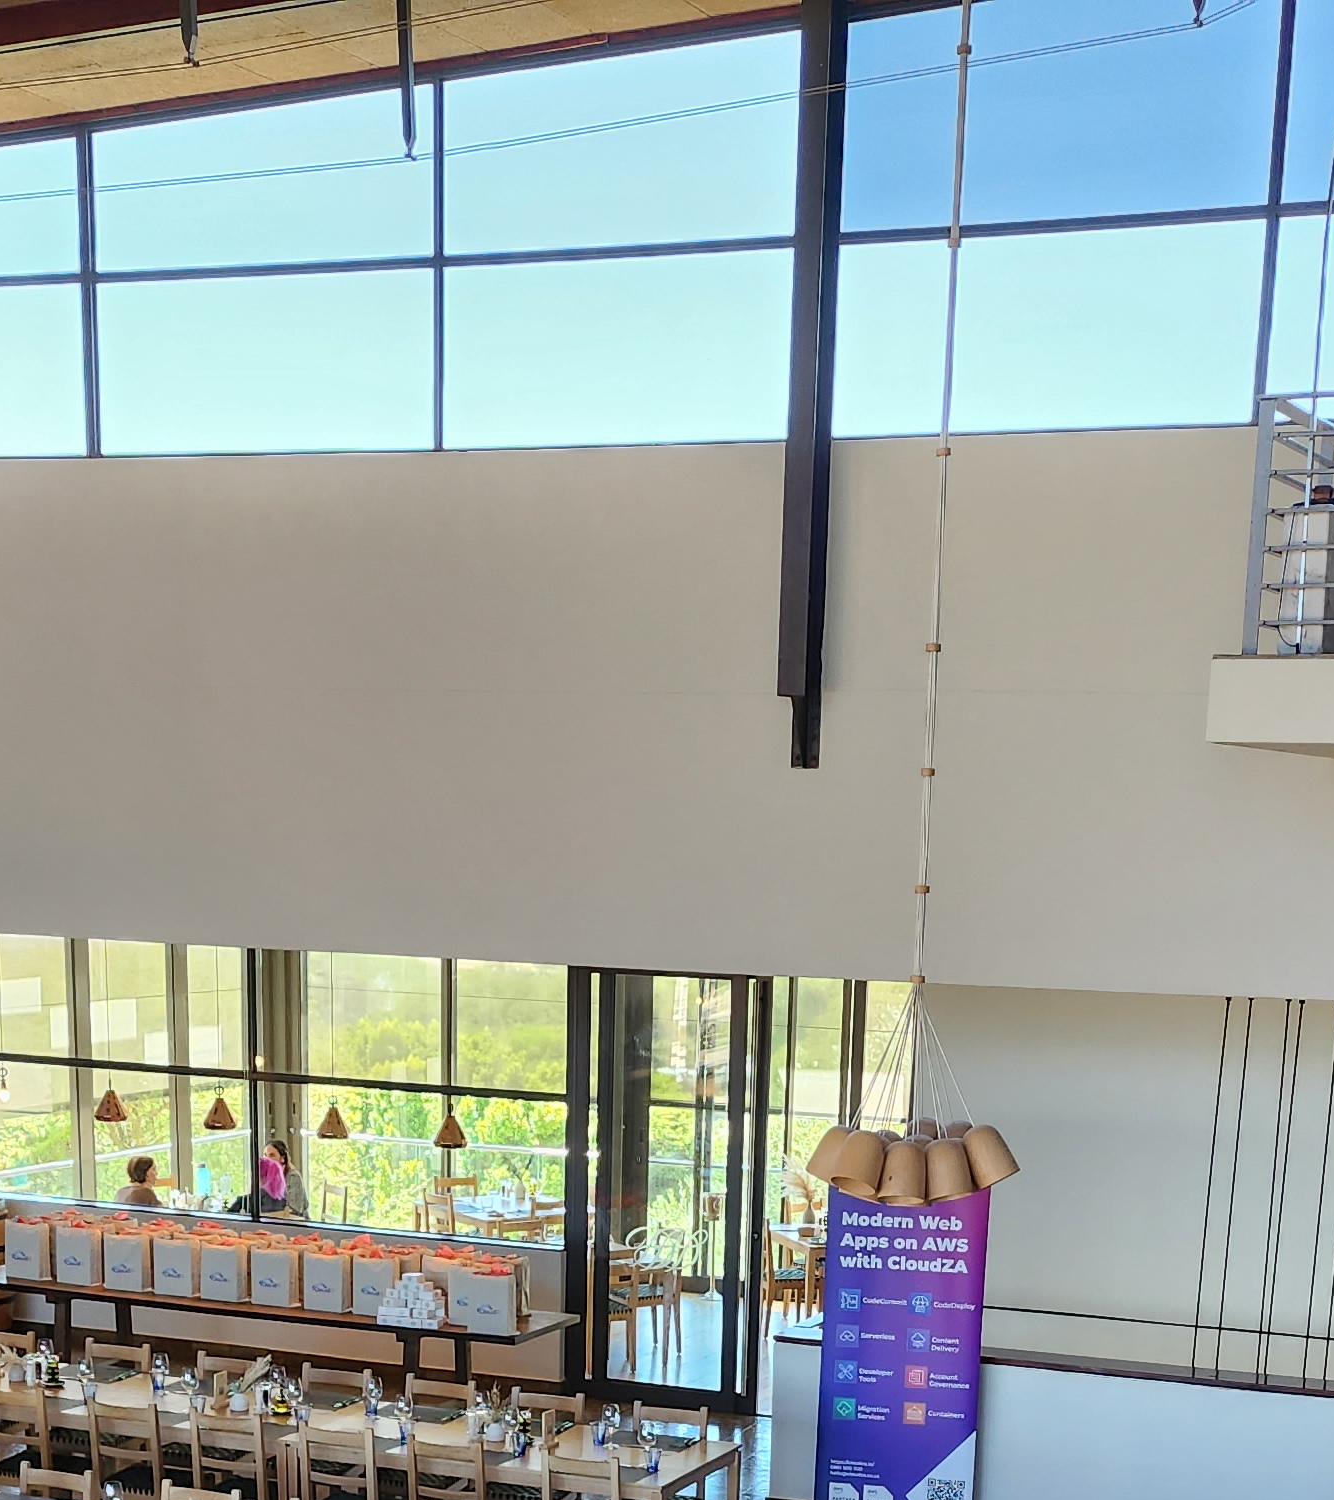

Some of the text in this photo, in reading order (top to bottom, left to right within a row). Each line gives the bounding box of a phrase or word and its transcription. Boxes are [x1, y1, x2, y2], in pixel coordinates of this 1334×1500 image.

[841, 1212, 962, 1231] Modern Web
[840, 1233, 969, 1252] Apps on AWS
[840, 1253, 969, 1274] with CloudZA
[933, 1301, 976, 1311] CodeDeploy
[931, 1337, 960, 1345] Content
[931, 1345, 959, 1353] Delivery
[858, 1375, 877, 1383] Tools
[929, 1373, 958, 1381] Account
[857, 1405, 890, 1413] Migration
[857, 1412, 886, 1421] Services
[927, 1410, 965, 1419] Containers
